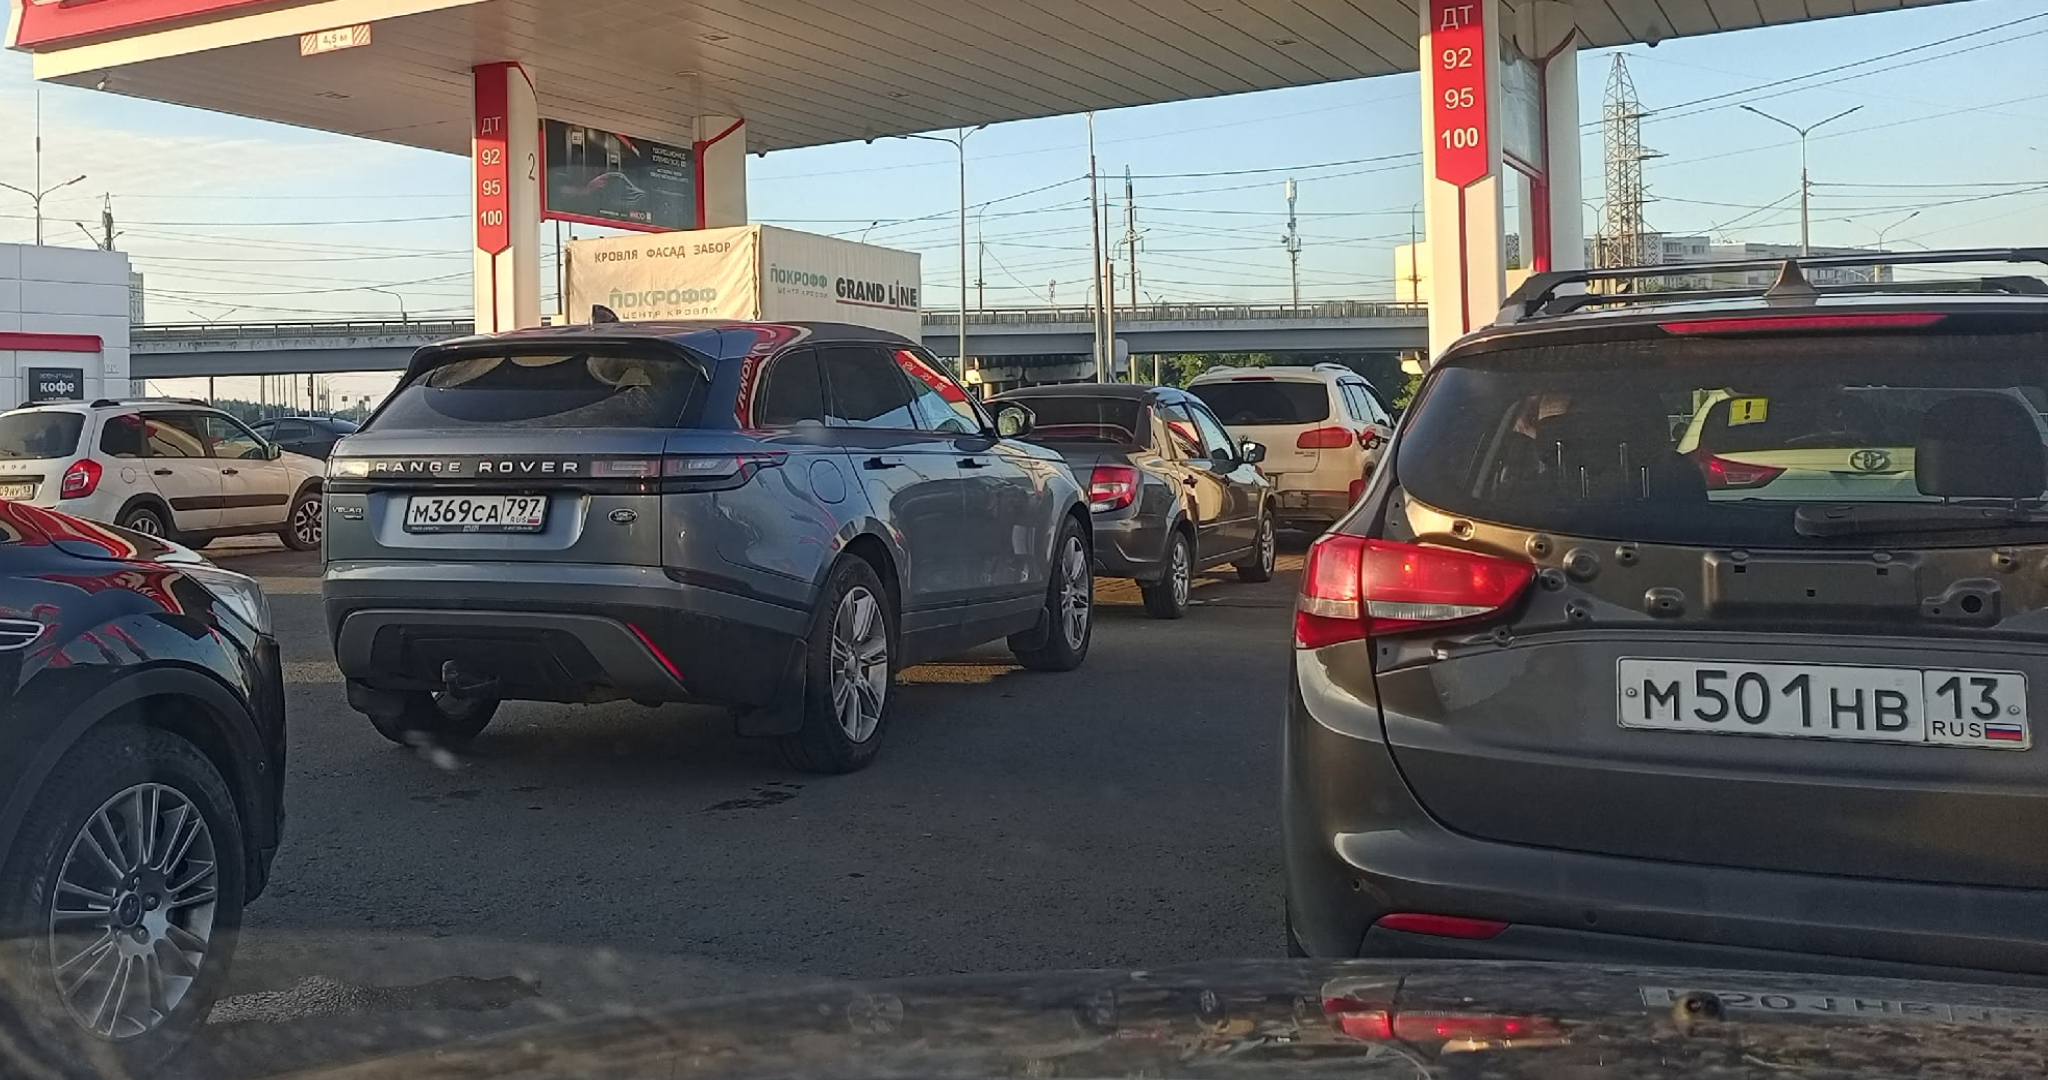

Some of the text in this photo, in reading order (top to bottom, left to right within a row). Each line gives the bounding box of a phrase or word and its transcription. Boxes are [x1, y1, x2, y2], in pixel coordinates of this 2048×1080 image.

[1441, 5, 1473, 31] ДТ
[323, 34, 337, 46] 4,5
[1443, 47, 1473, 70] 92
[1444, 87, 1475, 110] 95
[481, 116, 502, 136] ДТ
[1441, 127, 1479, 149] 100
[481, 148, 501, 166] 92
[527, 152, 536, 181] 2
[482, 179, 501, 196] 95
[480, 209, 503, 226] 100
[594, 242, 731, 263] КРОВЛЯ ФАСАД ЗАБОР
[770, 263, 828, 289] ПОКРОФФ
[608, 287, 718, 310] ПОКРОФФ
[835, 277, 886, 304] GRAND
[622, 307, 718, 320] ЦЕНТР КРОВЛИ
[40, 380, 75, 395] кофе
[375, 461, 579, 473] RANGE ROVER
[413, 498, 540, 523] М369СА 797
[1642, 669, 2000, 732] М501НВ 13
[1932, 720, 1982, 738] RUS
